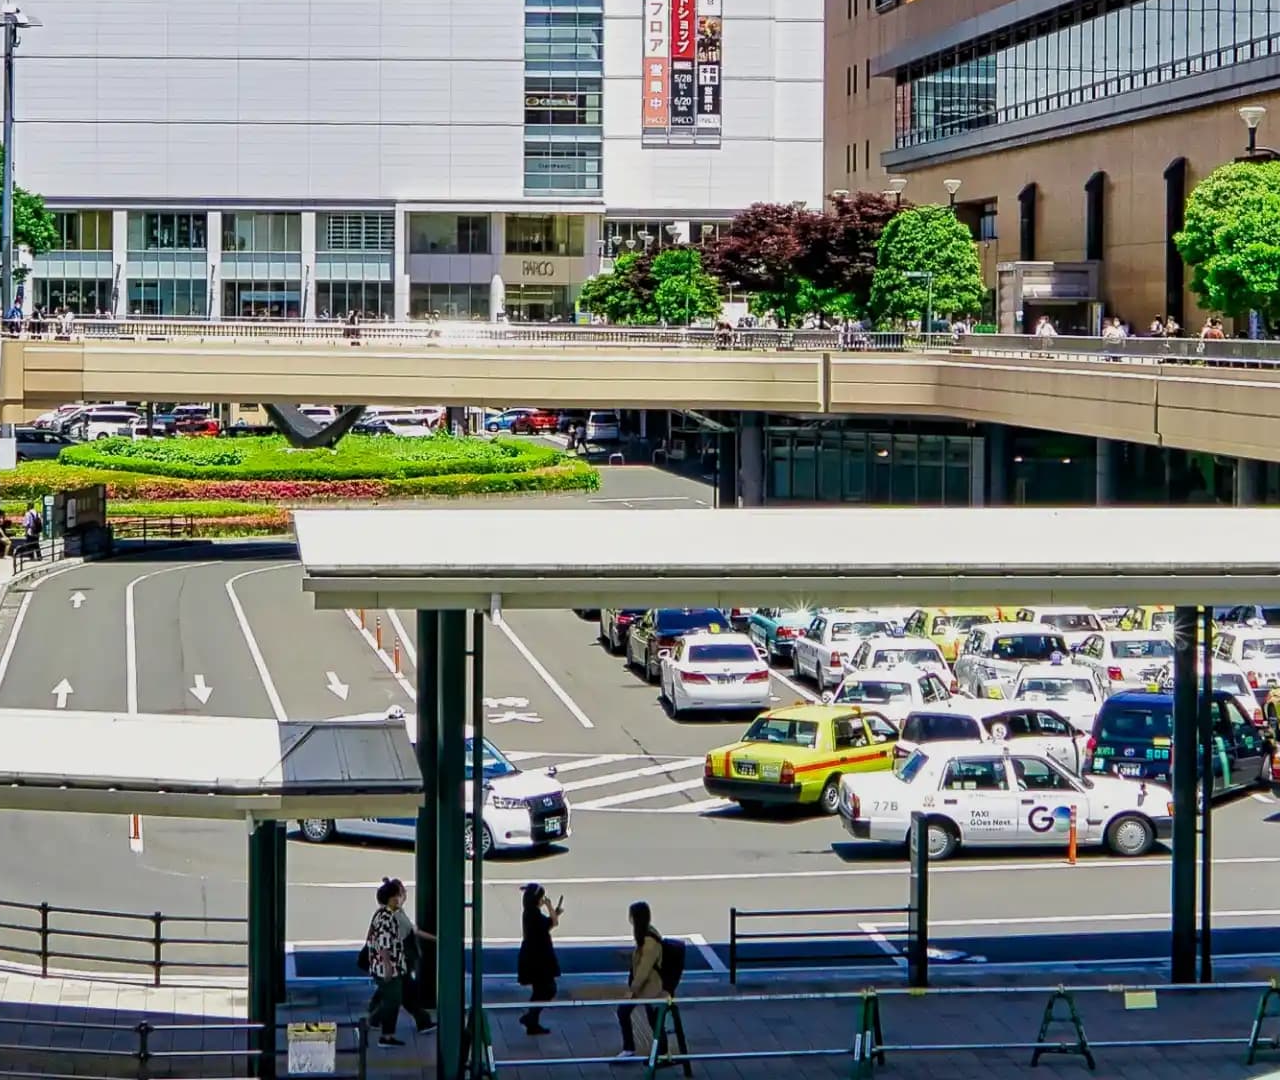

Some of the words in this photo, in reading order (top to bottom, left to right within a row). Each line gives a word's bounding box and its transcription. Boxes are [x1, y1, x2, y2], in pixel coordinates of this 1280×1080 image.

[674, 74, 692, 83] 5/28
[674, 97, 692, 106] 6/20
[522, 260, 554, 276] PARCO
[970, 810, 989, 818] TAXI
